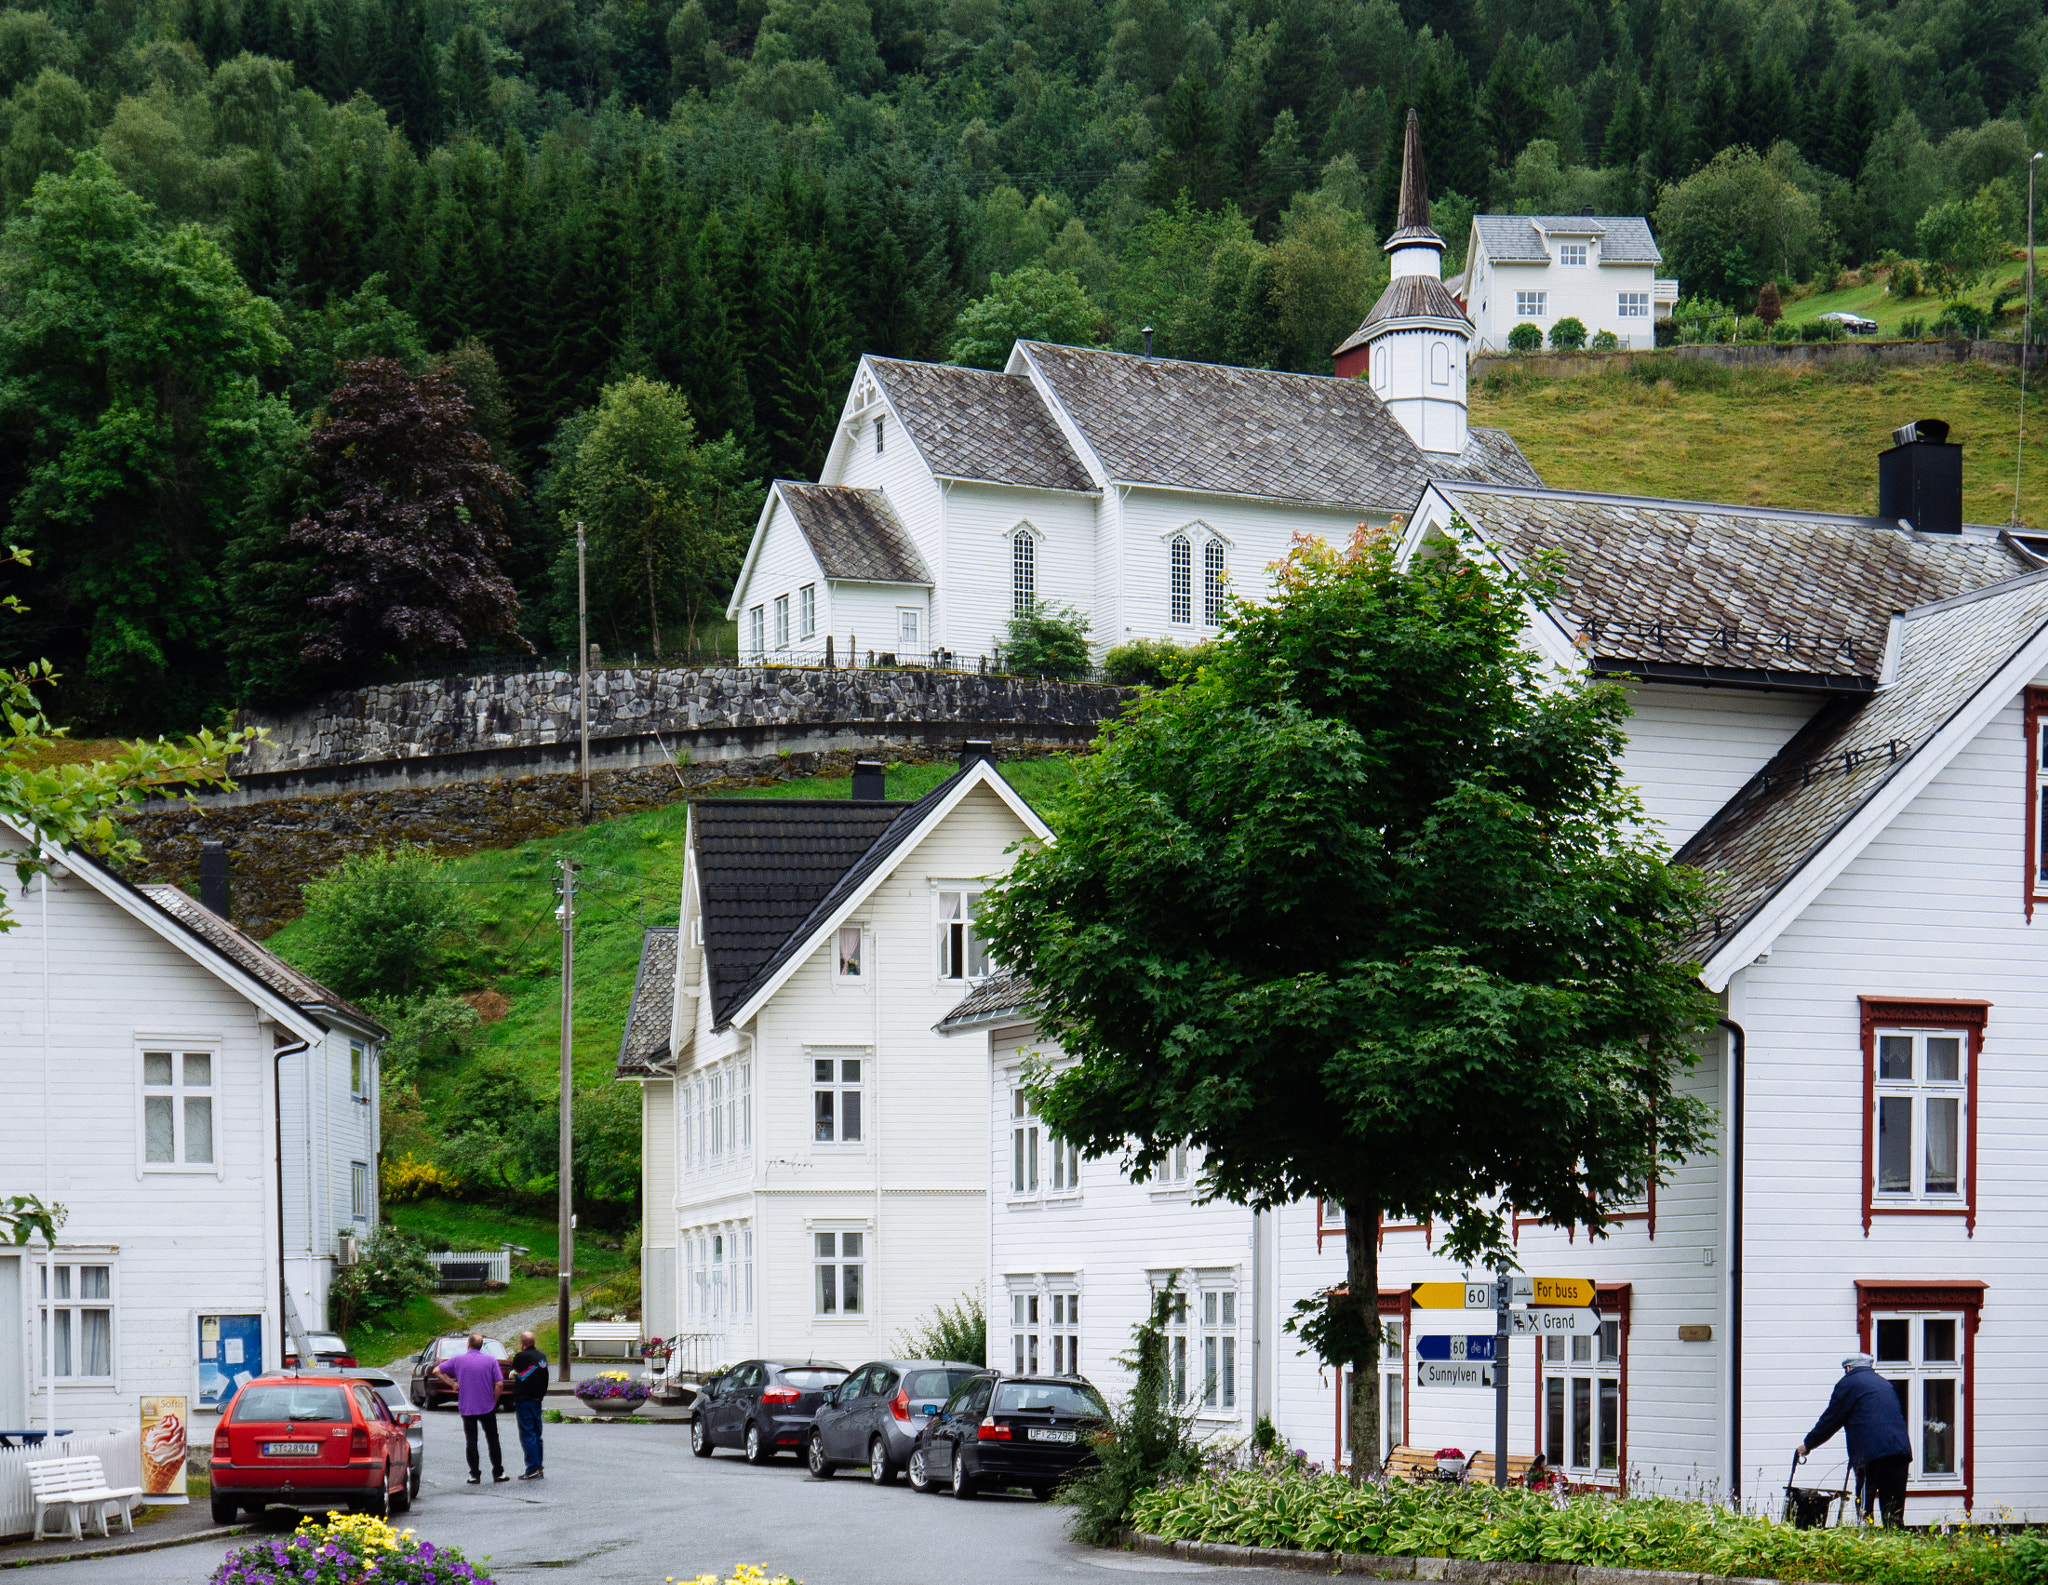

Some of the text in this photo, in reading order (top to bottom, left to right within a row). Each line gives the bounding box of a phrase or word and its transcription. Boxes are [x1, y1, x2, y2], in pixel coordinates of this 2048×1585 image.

[1468, 1289, 1485, 1303] 60
[1537, 1281, 1578, 1299] For buss
[1543, 1313, 1575, 1329] Grand
[1453, 1341, 1465, 1355] 60
[1429, 1365, 1477, 1386] Sunnylven
[160, 1399, 184, 1408] Softis
